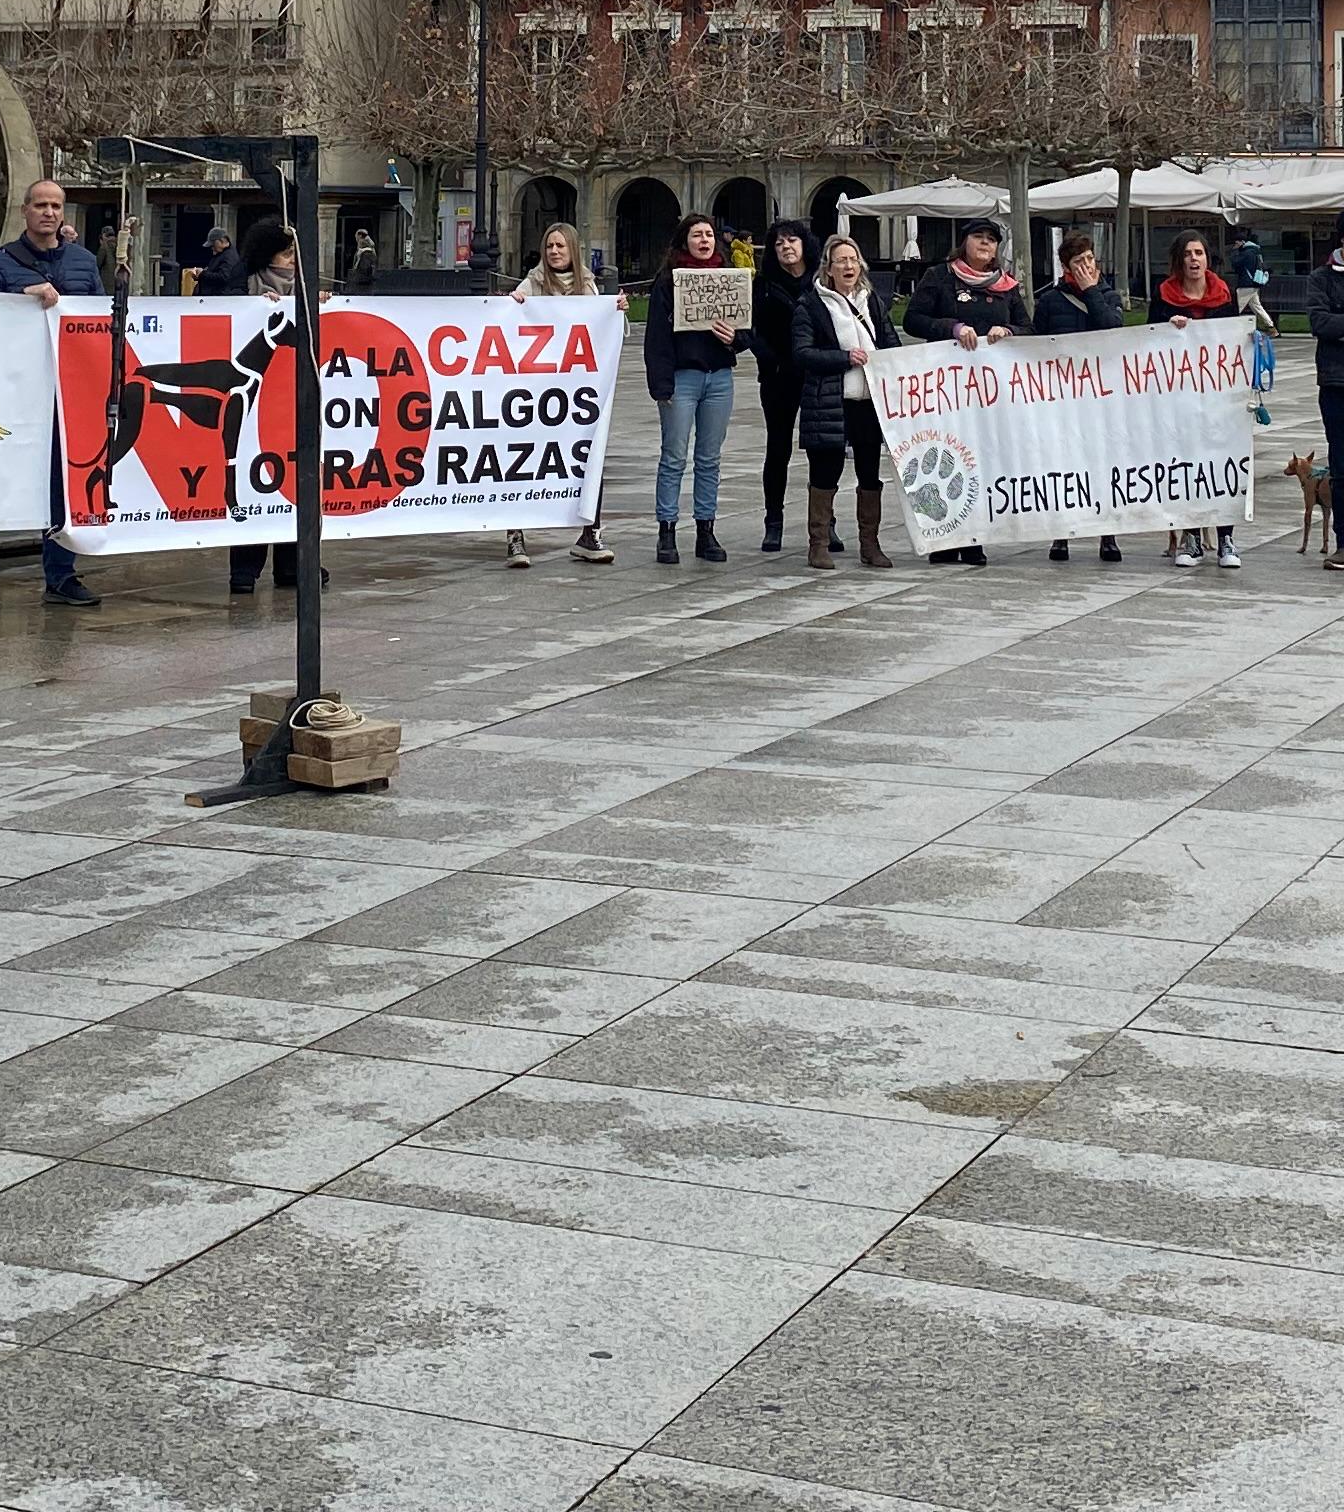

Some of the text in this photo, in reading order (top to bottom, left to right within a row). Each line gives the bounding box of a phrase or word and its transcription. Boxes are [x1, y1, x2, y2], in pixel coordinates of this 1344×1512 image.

[683, 292, 739, 306] LLEGA TU
[685, 284, 738, 296] ANIMAL
[66, 322, 139, 335] ORGANA,
[325, 324, 599, 377] A LA CAZA
[881, 344, 1250, 420] LIBERTAD ANIMAL NAVARRA
[324, 387, 600, 431] ON GALGOS
[911, 429, 942, 445] ANIMAL
[180, 466, 207, 498] Y
[437, 439, 593, 485] RAZAS
[1111, 457, 1251, 509] RESPÉTALOS
[120, 508, 151, 523] más
[155, 504, 227, 521] indefensa
[231, 502, 262, 516] está
[267, 503, 293, 515] una
[360, 497, 388, 510] más
[392, 493, 448, 508] derecho
[452, 492, 485, 505] tiene
[488, 494, 496, 502] a
[500, 492, 522, 502] ser
[525, 487, 582, 500] defendid
